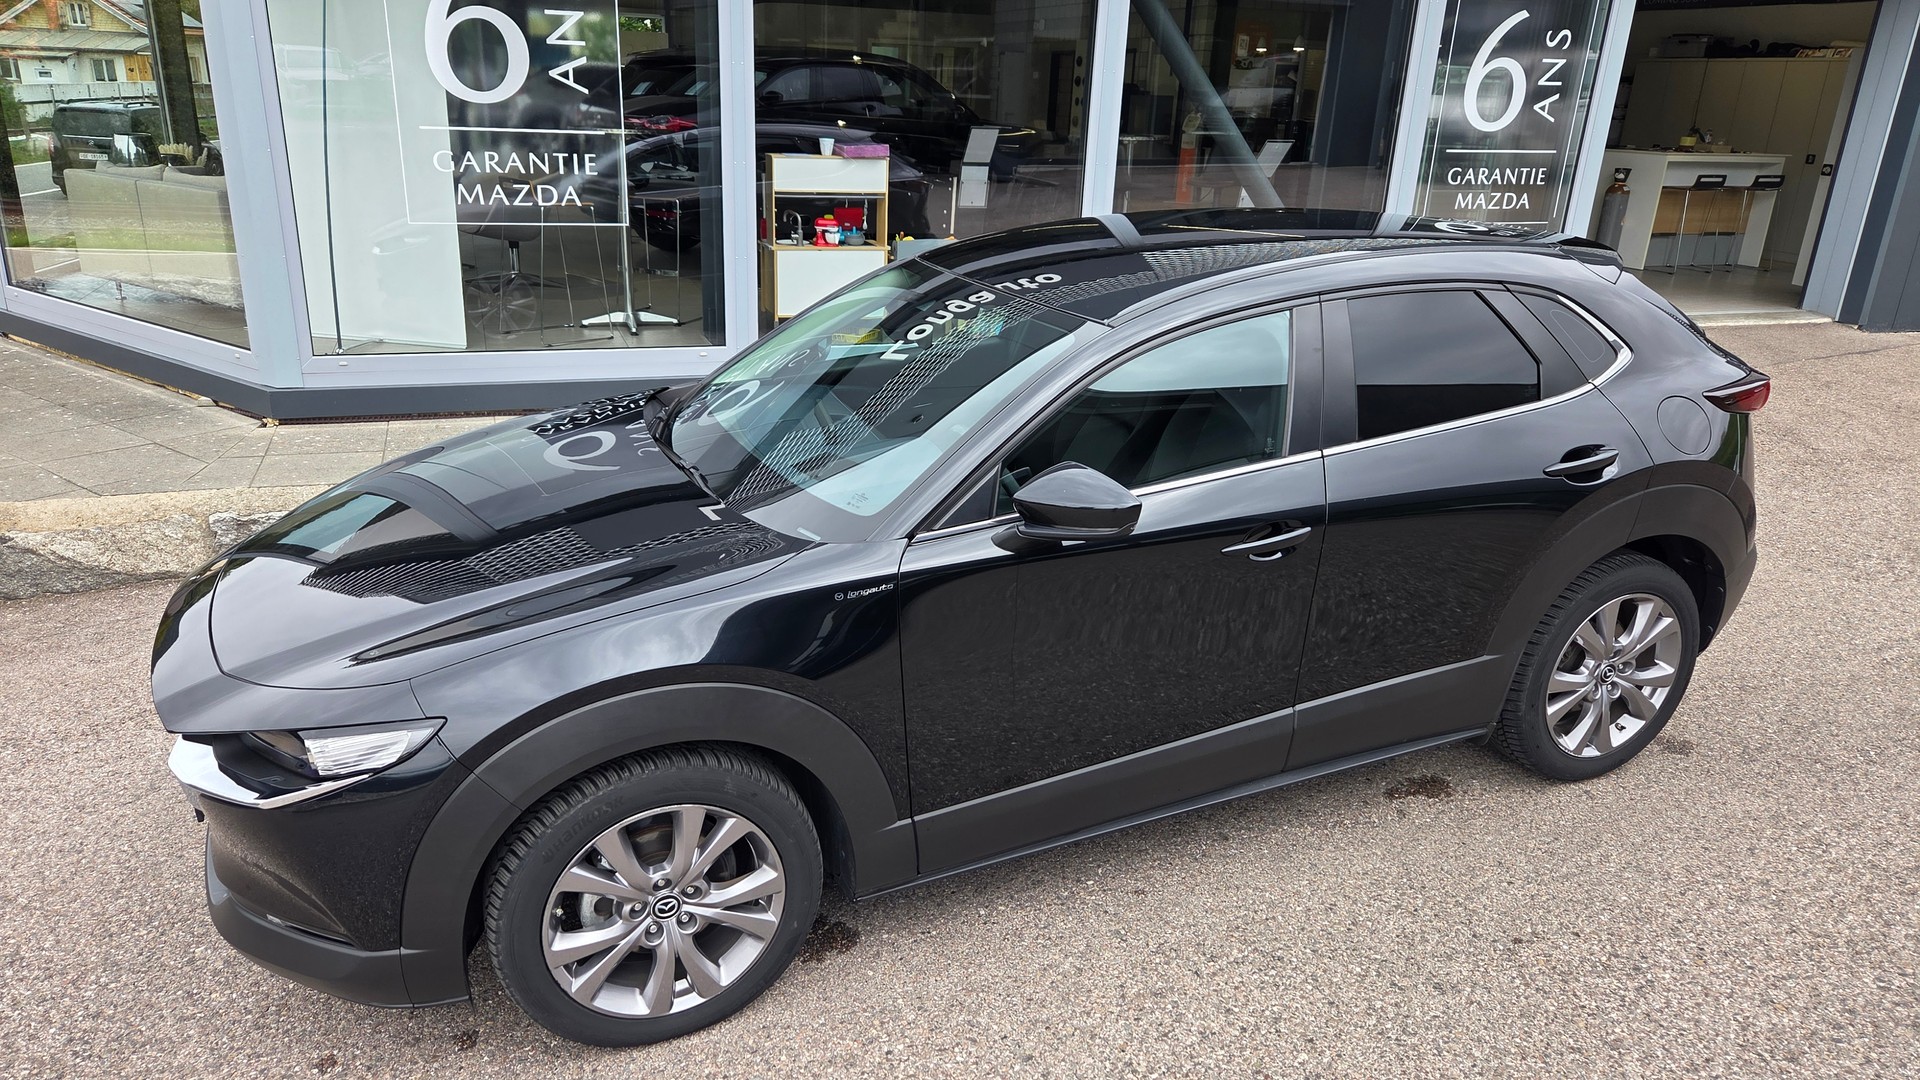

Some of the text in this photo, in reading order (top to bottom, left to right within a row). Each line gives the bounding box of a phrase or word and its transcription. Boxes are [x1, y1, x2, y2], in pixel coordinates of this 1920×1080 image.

[1463, 9, 1530, 132] 6
[1533, 28, 1572, 123] ANS
[432, 150, 598, 176] GARANTIE
[1447, 167, 1547, 186] GARANTIE
[456, 183, 582, 207] MAZDA
[1454, 192, 1530, 210] MAZDA
